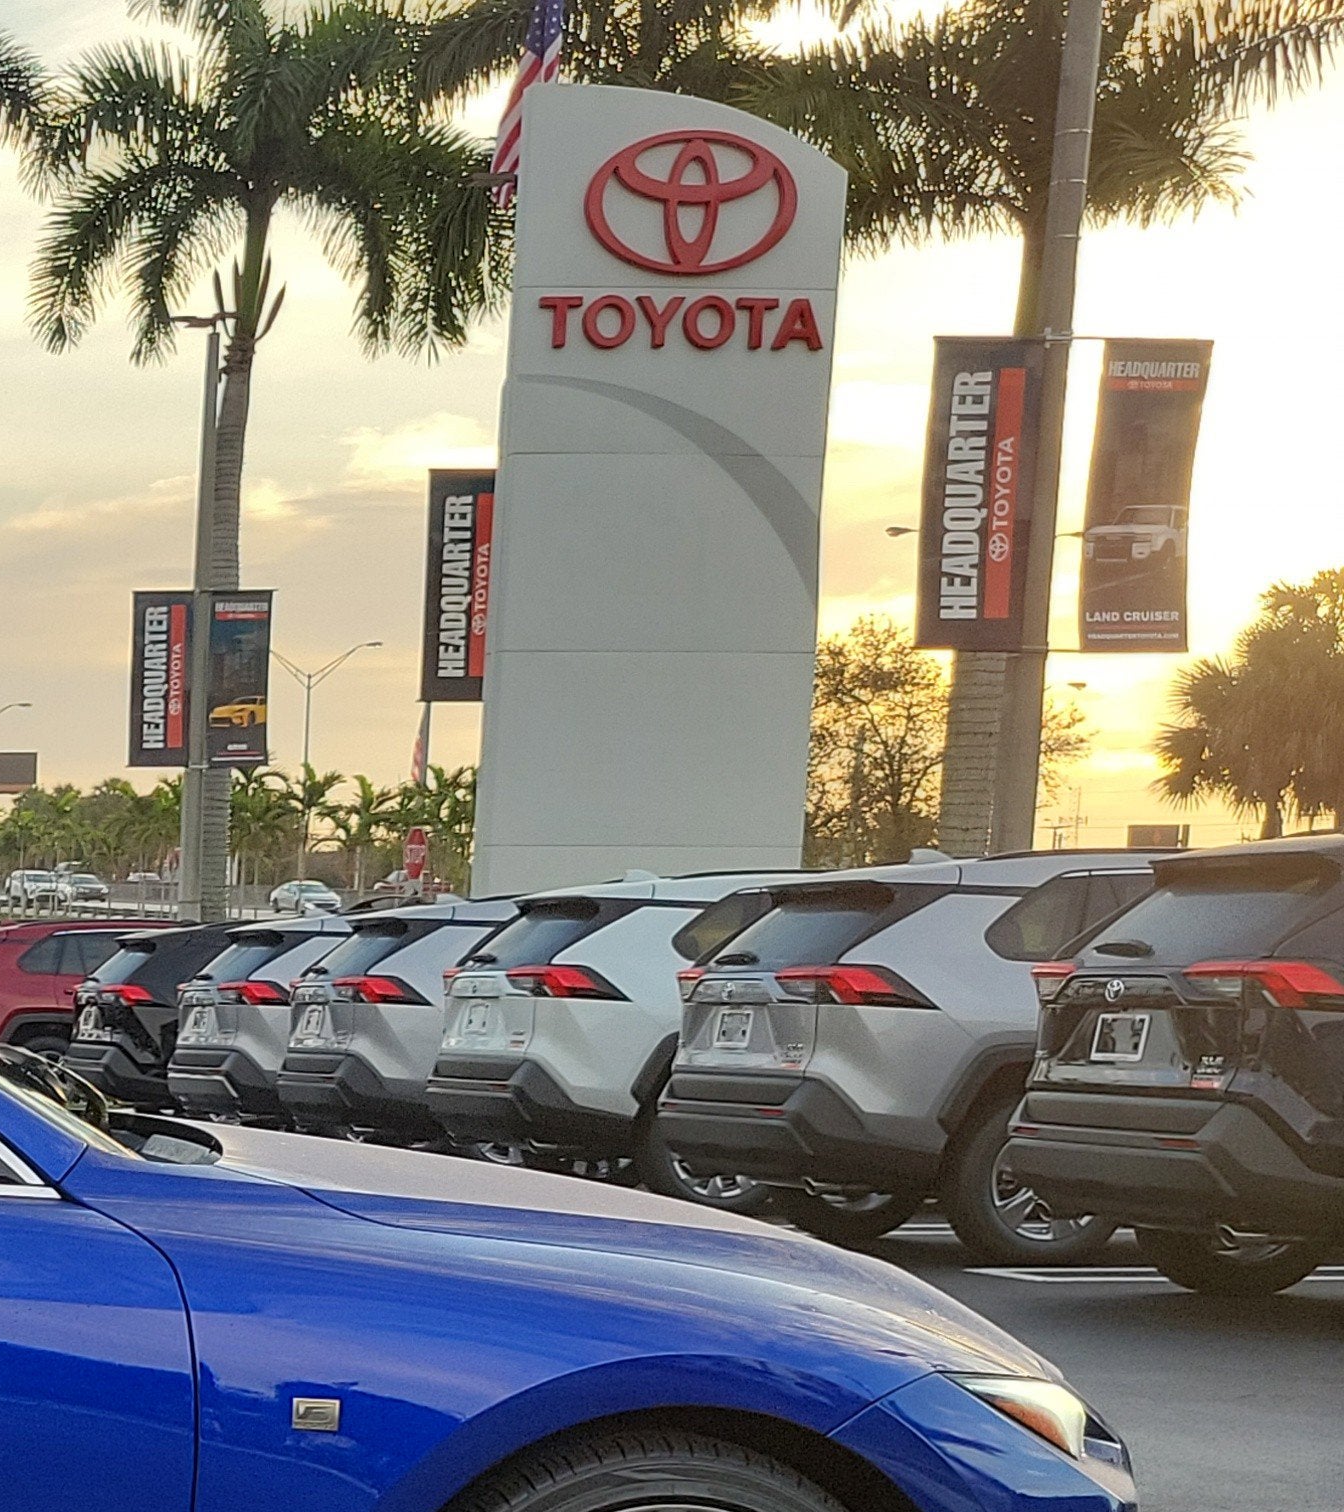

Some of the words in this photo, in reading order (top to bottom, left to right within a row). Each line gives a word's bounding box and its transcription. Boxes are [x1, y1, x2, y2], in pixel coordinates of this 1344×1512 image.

[538, 295, 824, 351] TOYOTA
[1108, 361, 1200, 379] HEADQUARTER
[939, 370, 993, 621] HEADQUARTER
[992, 436, 1015, 531] TOYOTA
[437, 495, 474, 678] HEADQUARTER
[474, 542, 490, 613] TOYOTA
[1085, 611, 1120, 622] LAND
[1123, 611, 1180, 622] CRUISER
[142, 606, 169, 749] HEADQUARTER
[169, 643, 182, 696] TOYOTA
